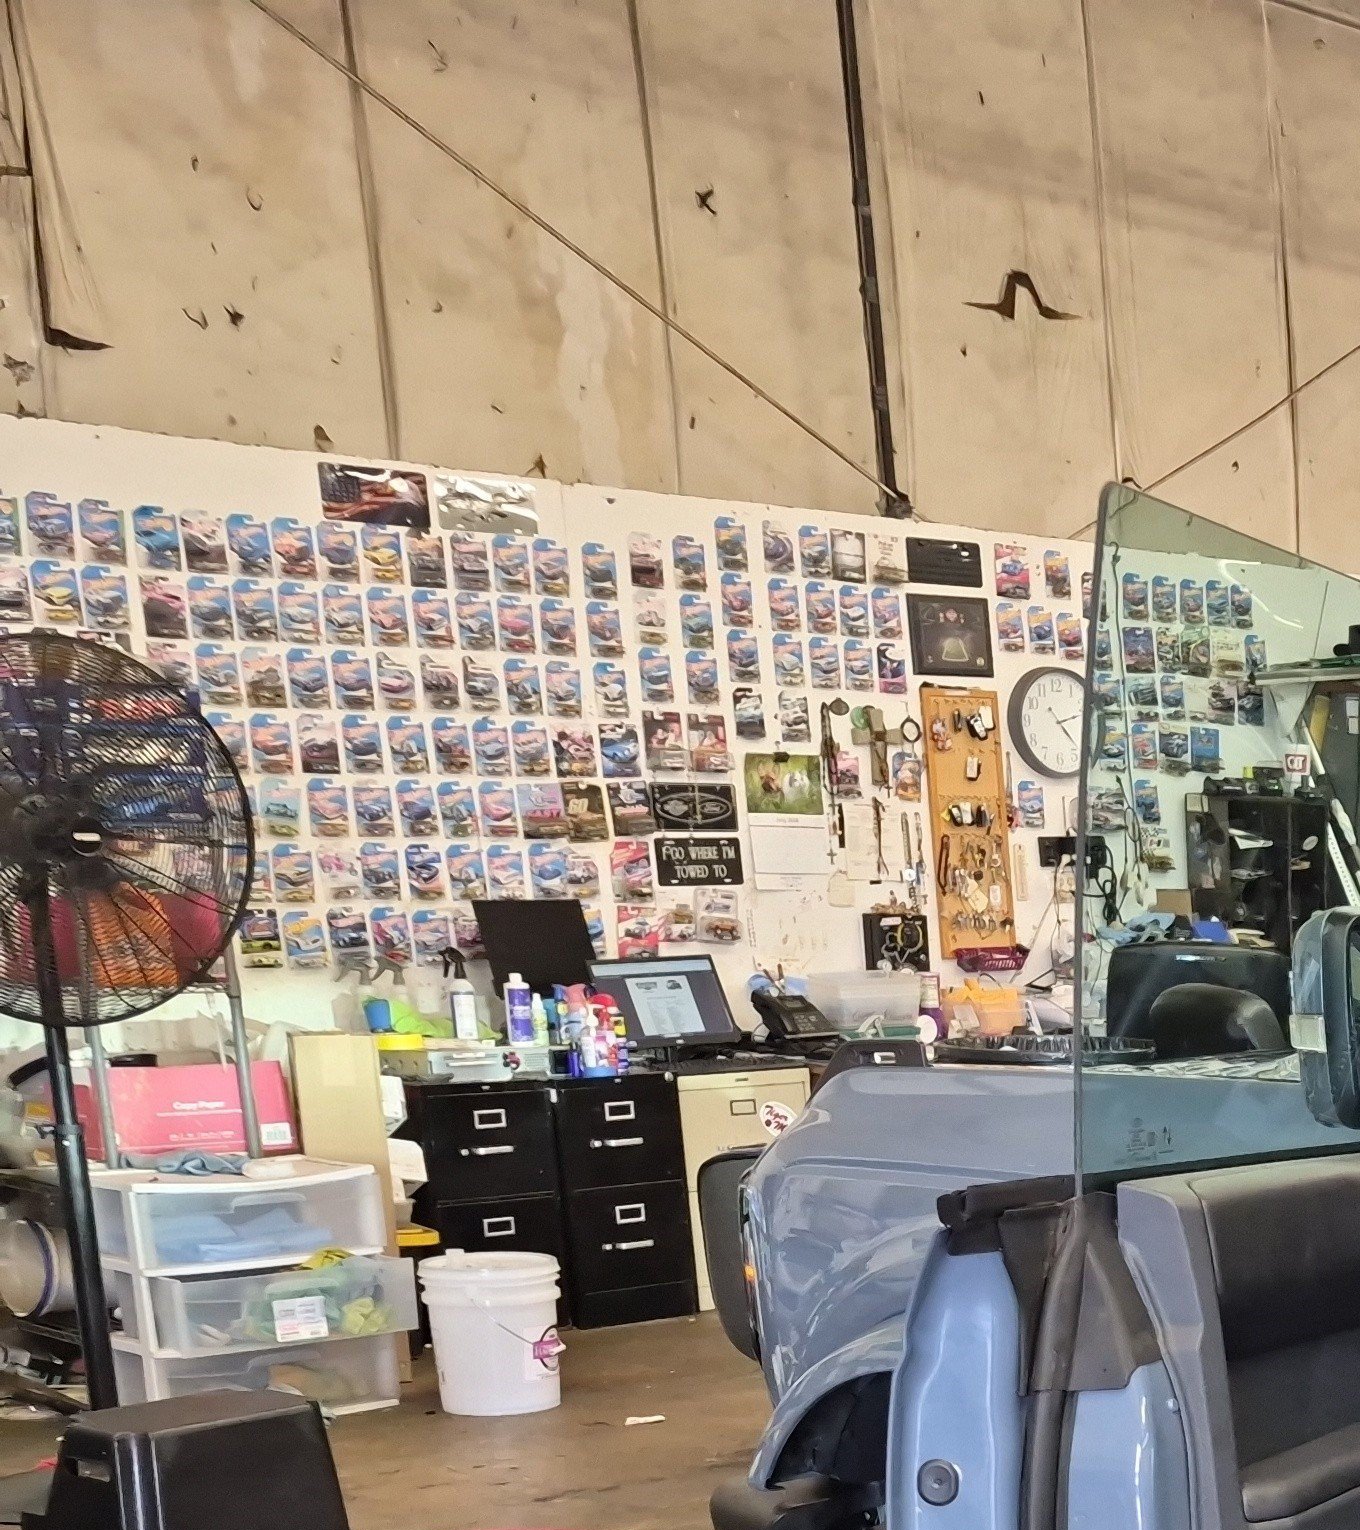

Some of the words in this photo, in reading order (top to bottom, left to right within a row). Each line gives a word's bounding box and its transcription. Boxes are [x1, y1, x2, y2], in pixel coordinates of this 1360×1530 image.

[1038, 683, 1046, 697] 11
[1050, 679, 1062, 692] 12
[1028, 697, 1038, 710] 10
[1023, 714, 1031, 727] 9
[1029, 733, 1037, 747] 8
[1057, 753, 1064, 766] 6
[688, 846, 719, 860] WHERE
[674, 864, 709, 879] TOWED
[712, 864, 727, 878] TO
